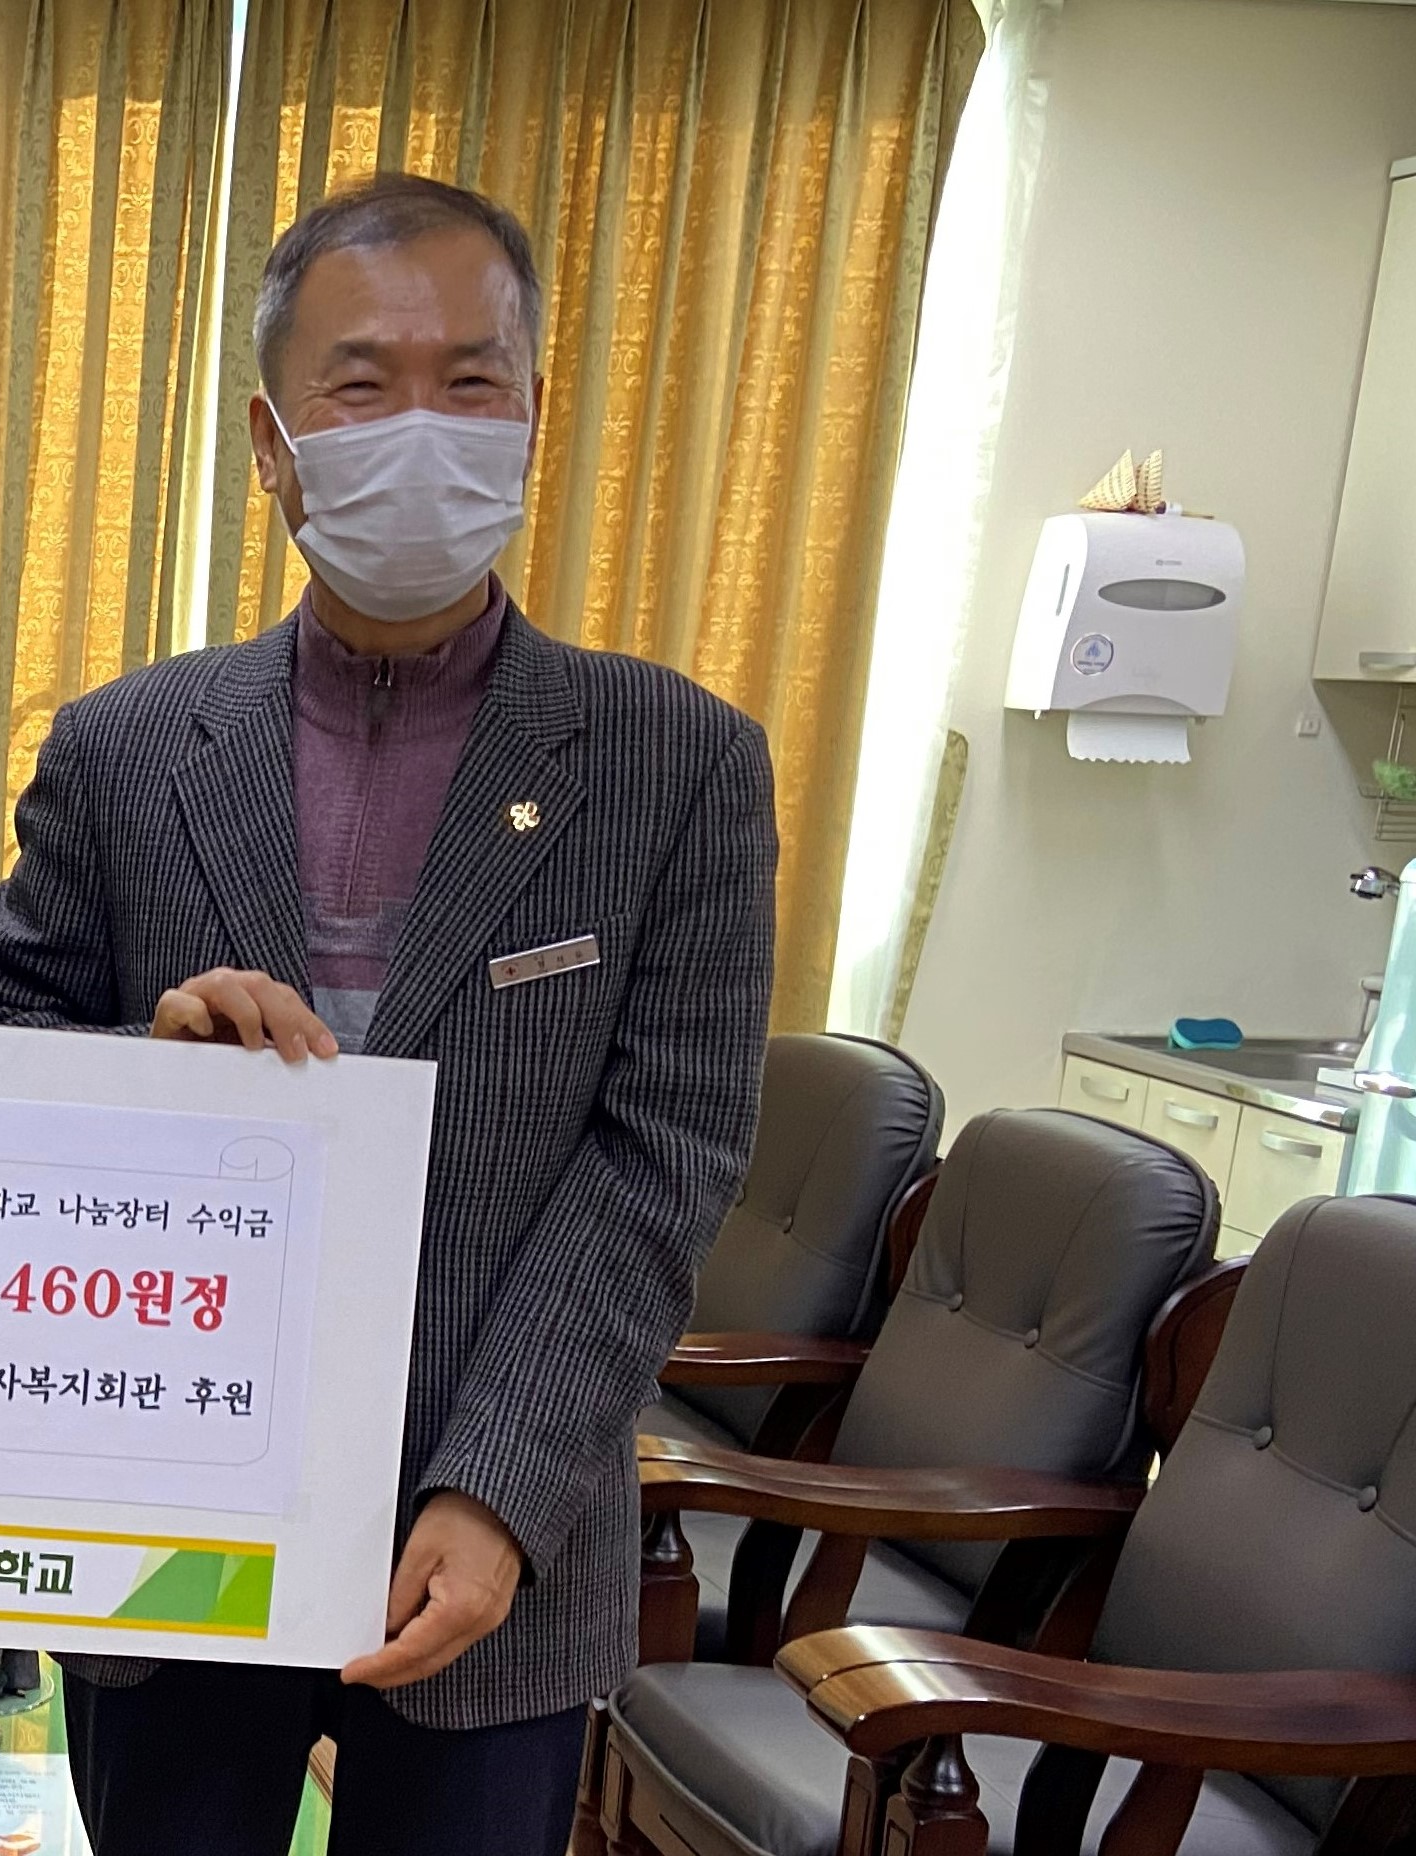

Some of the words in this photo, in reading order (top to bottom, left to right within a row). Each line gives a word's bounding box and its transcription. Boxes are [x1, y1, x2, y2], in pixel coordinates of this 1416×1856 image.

[59, 1193, 169, 1232] 나눔장터
[186, 1203, 273, 1238] 수익금
[185, 1376, 253, 1416] 후원
